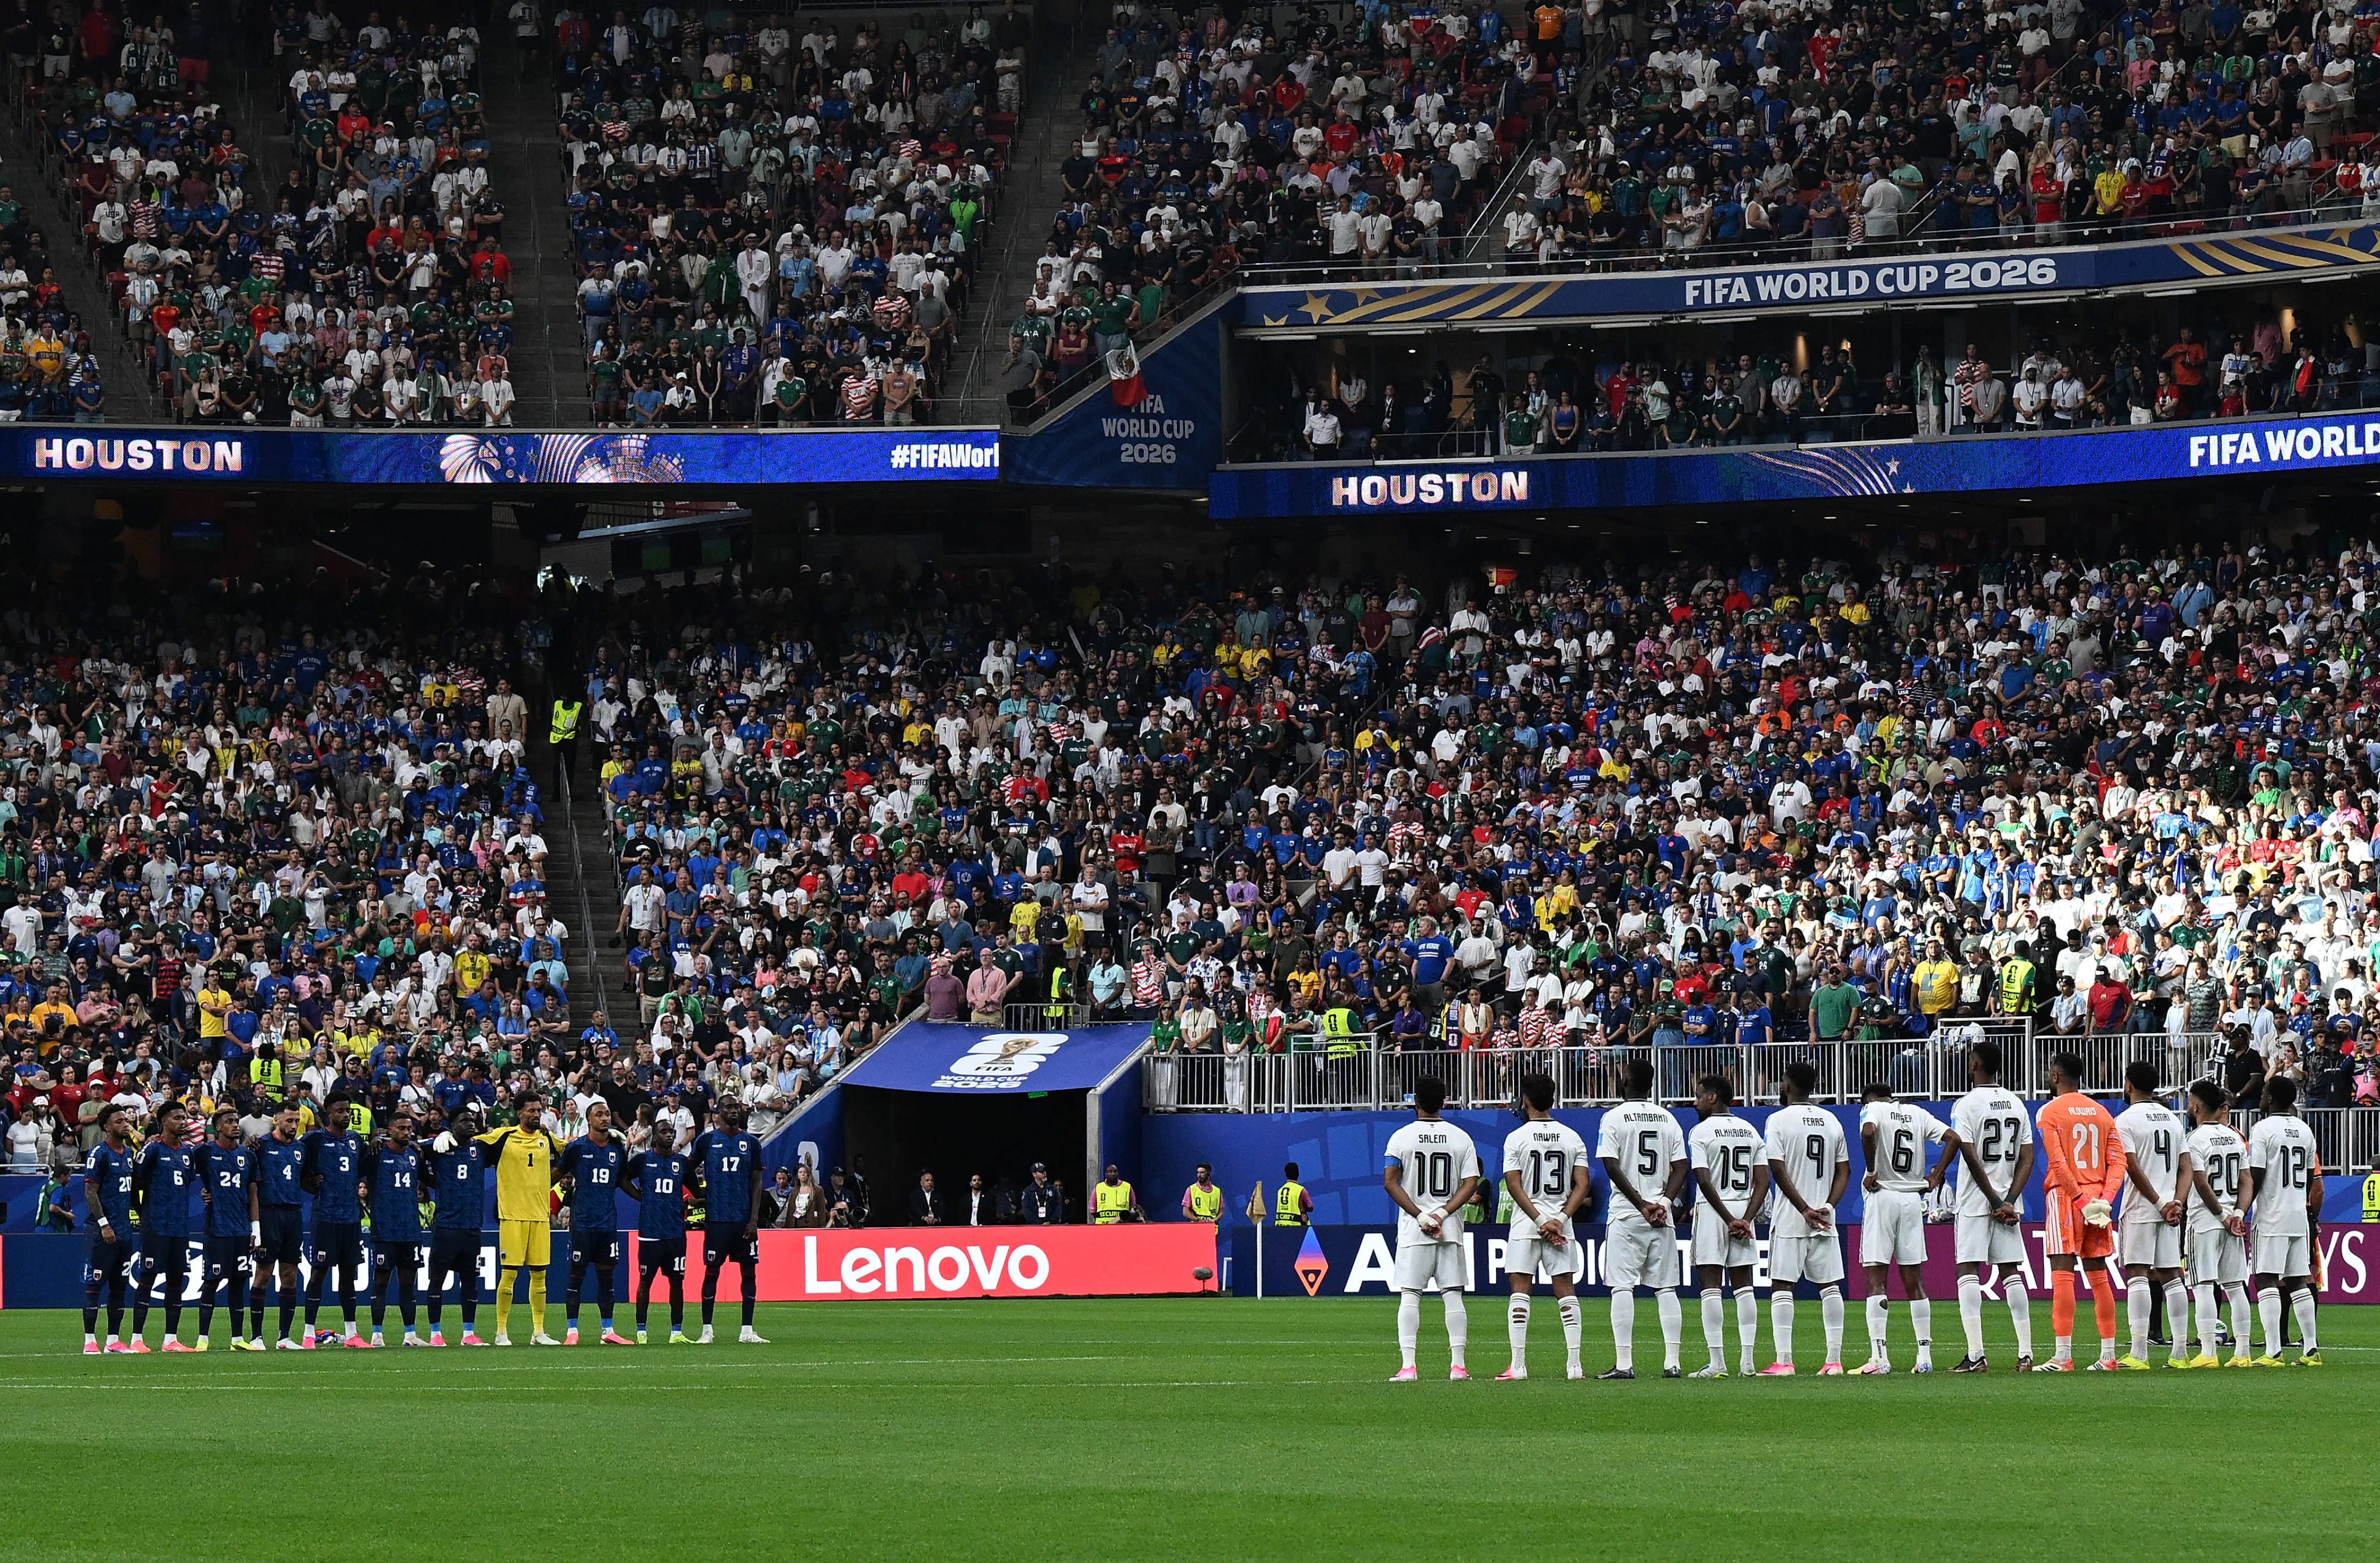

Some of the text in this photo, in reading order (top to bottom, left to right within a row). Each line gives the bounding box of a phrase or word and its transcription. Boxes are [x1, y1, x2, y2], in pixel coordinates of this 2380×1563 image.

[1685, 258, 2056, 306] FIFA WORLD CUP 2026
[1102, 418, 1194, 439] WORLD CUP
[35, 438, 242, 471] HOUSTON
[1121, 443, 1176, 464] 2026
[2190, 432, 2261, 467] FIFA
[1332, 471, 1527, 506] HOUSTON
[525, 785, 535, 802] ABO
[931, 1080, 1022, 1088] 2026
[1989, 1100, 2012, 1110] KANNO
[1802, 1117, 1824, 1127] FERAS
[1419, 1134, 1447, 1144] SALEM
[1533, 1133, 1561, 1142] NAWAF
[1981, 1117, 2021, 1163] 23
[2285, 1128, 2299, 1138] SAUD
[1638, 1130, 1658, 1176] 5
[1891, 1129, 1914, 1174] 6
[2072, 1123, 2099, 1169] 21
[2154, 1129, 2171, 1174] 4
[339, 1156, 349, 1171] 3
[527, 1153, 534, 1167] 1
[722, 1156, 740, 1172] 17
[1806, 1134, 1824, 1180] 9
[2280, 1144, 2306, 1189] 12
[173, 1170, 183, 1185] 6
[282, 1164, 292, 1180] 4
[457, 1164, 468, 1180] 8
[592, 1168, 610, 1184] 19
[1415, 1151, 1452, 1198] 10
[1530, 1150, 1566, 1197] 13
[1720, 1145, 1752, 1191] 15
[2209, 1153, 2241, 1197] 20
[119, 1176, 132, 1192] 20
[220, 1171, 241, 1188] 24
[394, 1172, 411, 1188] 14
[655, 1178, 674, 1193] 10
[804, 1236, 1050, 1293] Lenovo
